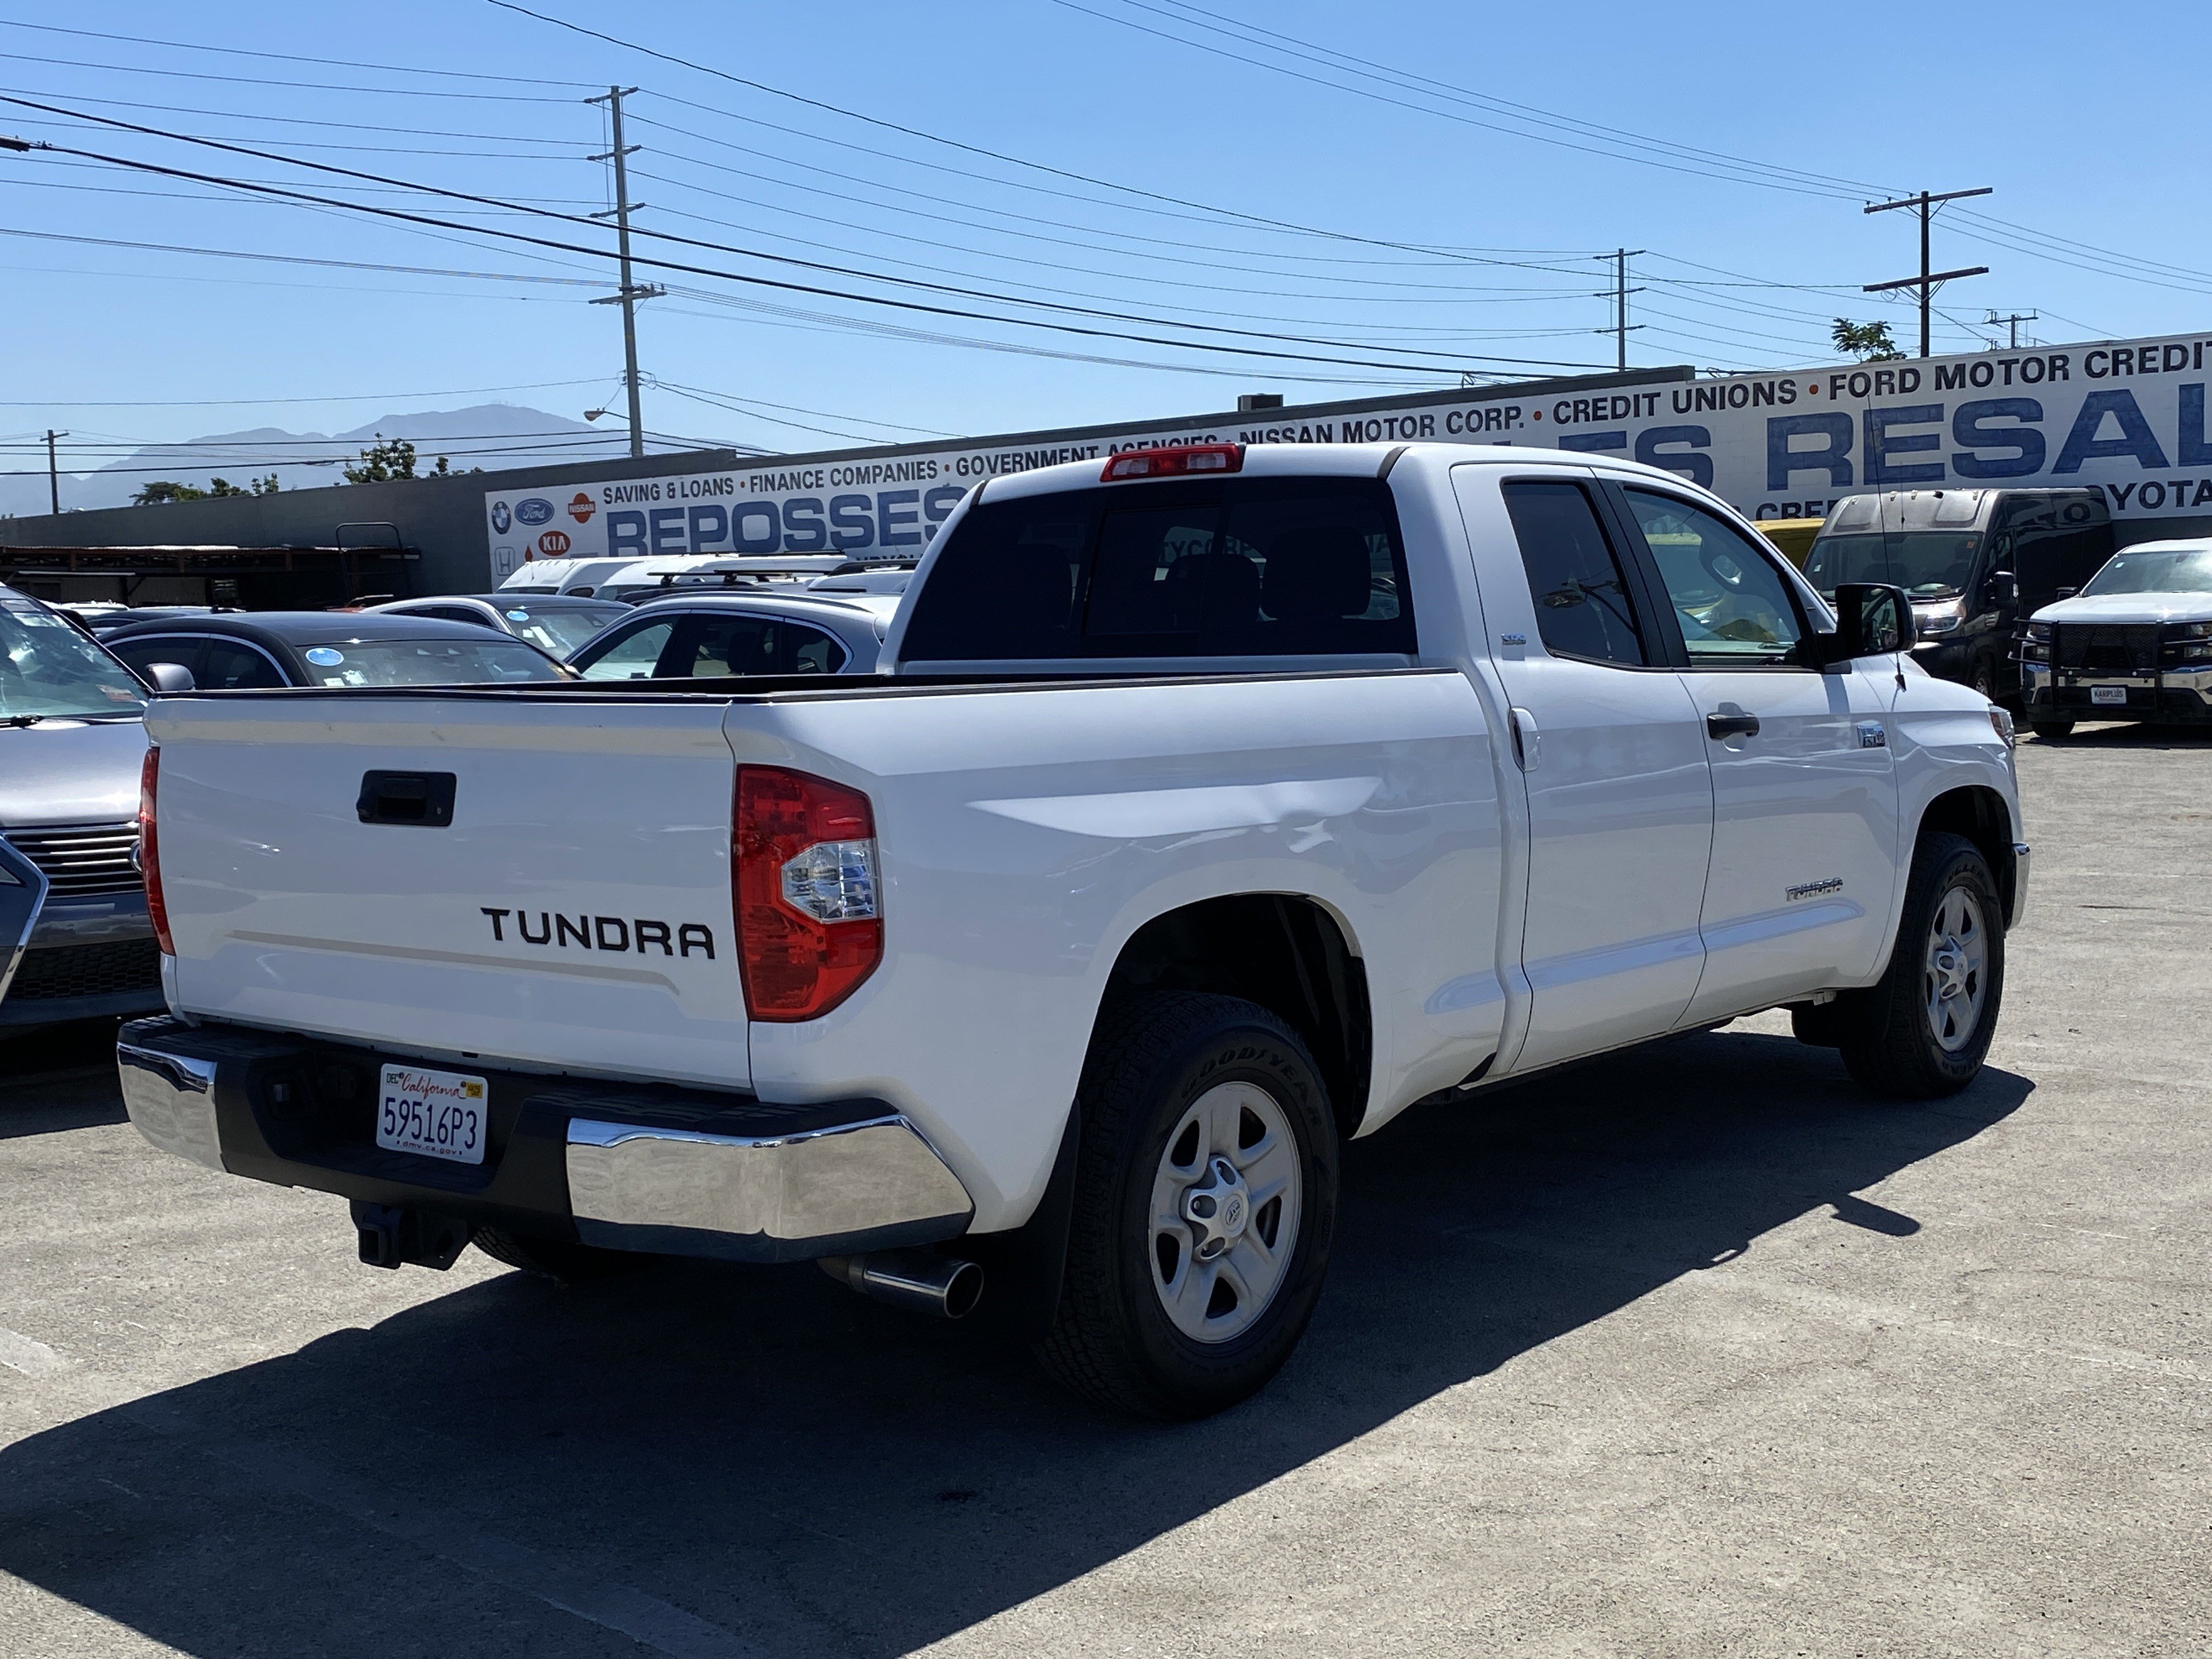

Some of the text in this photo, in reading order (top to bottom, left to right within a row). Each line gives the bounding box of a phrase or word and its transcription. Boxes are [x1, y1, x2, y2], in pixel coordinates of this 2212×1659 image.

[1829, 341, 2212, 400] FORD MOTOR CREDI
[1553, 379, 1797, 425] CREDIT UNIONS
[1342, 414, 1436, 443] MOTOR
[1445, 405, 1525, 435] CORP.
[603, 483, 661, 505] SAVING
[666, 482, 676, 499] &
[680, 477, 735, 498] LOANS
[749, 470, 825, 493] FINANCE
[830, 460, 938, 487] COMPANIES
[522, 503, 546, 520] Ford
[570, 503, 596, 514] NISSAN
[542, 535, 566, 551] KIA
[481, 907, 715, 959] TUNDRA
[386, 1073, 399, 1084] DEC
[402, 1074, 467, 1100] California
[384, 1097, 477, 1149] 59516P3
[403, 1141, 458, 1155] dmv.ca.gov
